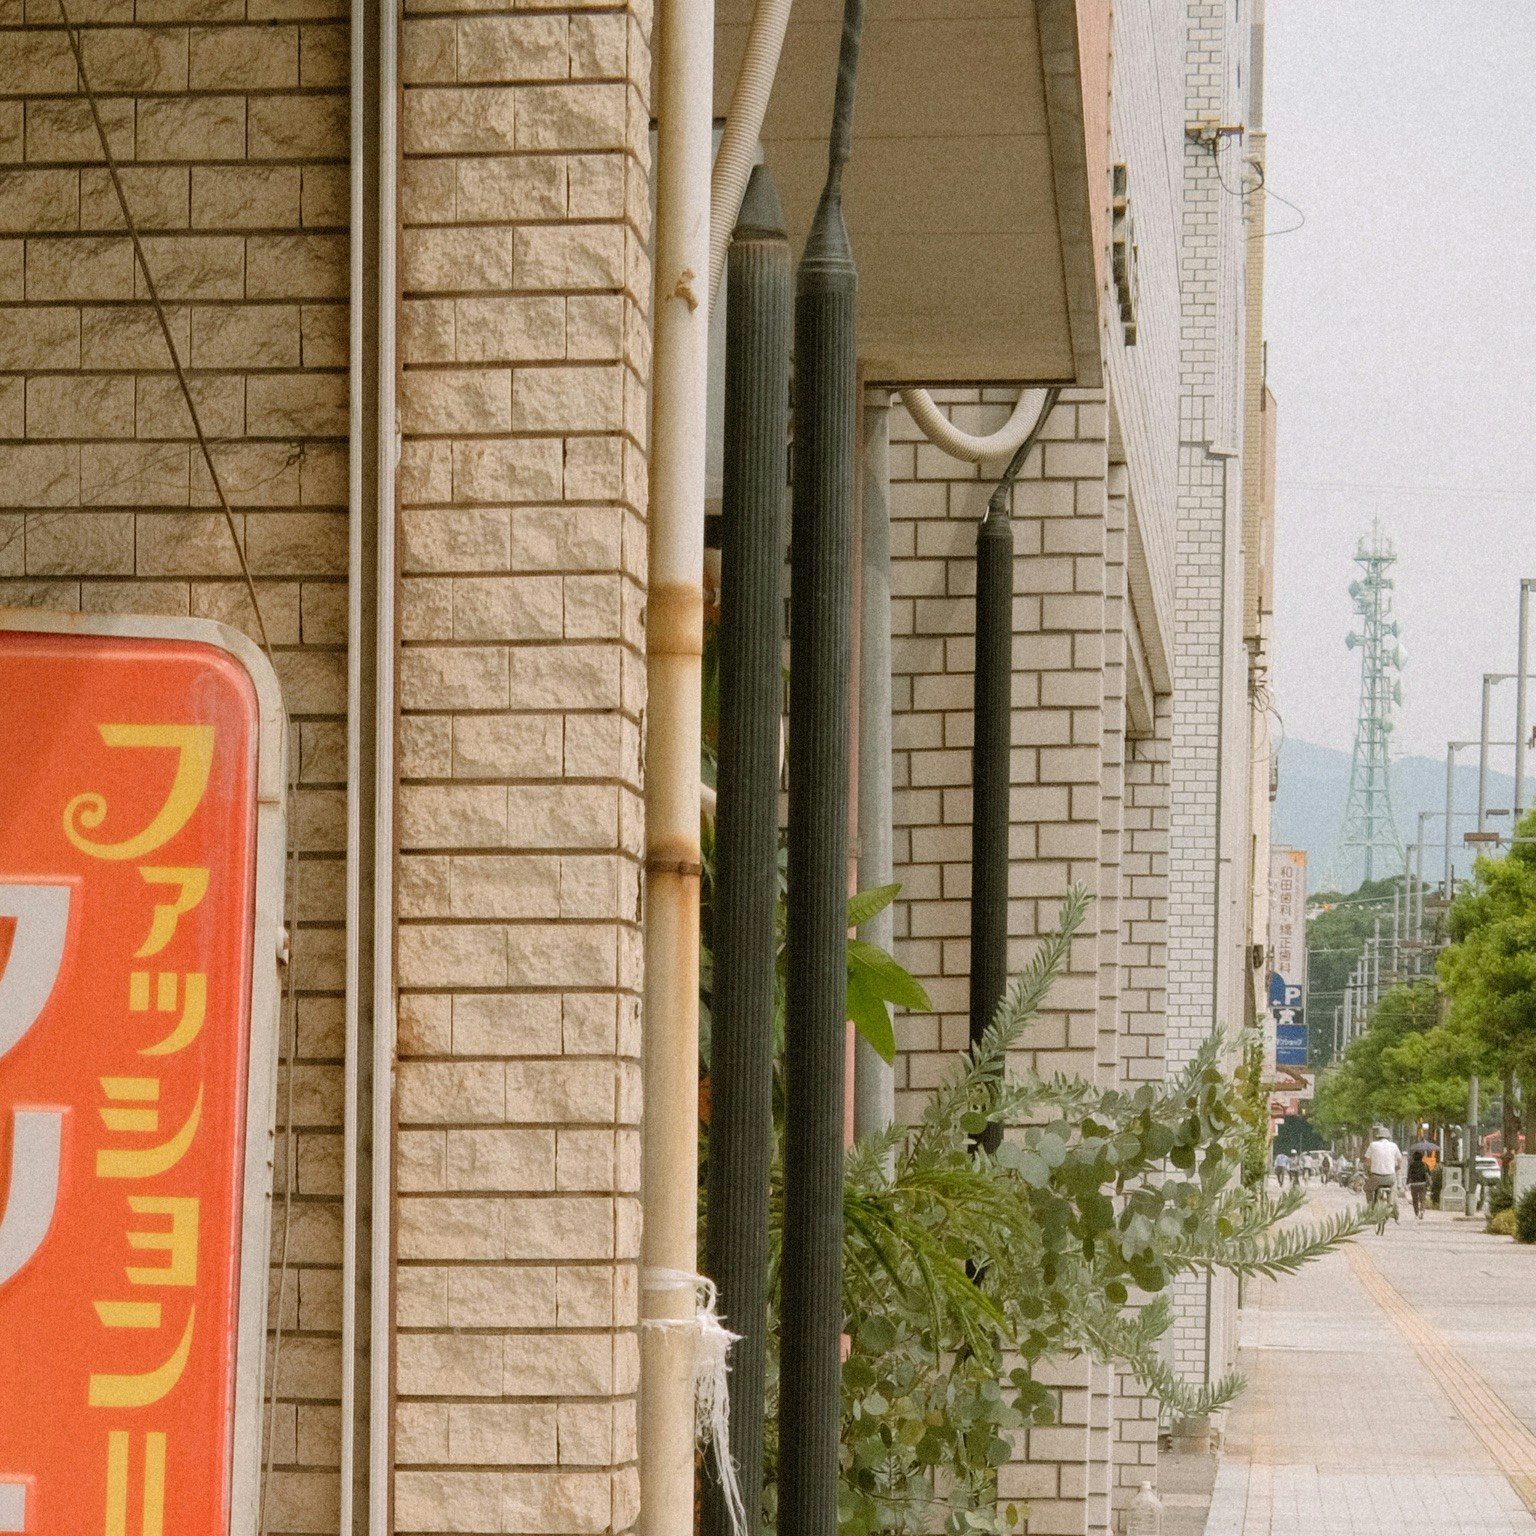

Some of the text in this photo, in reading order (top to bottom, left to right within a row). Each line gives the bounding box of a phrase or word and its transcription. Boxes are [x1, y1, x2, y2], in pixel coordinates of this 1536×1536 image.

[62, 723, 215, 1409] ファッション
[1284, 986, 1301, 1006] P
